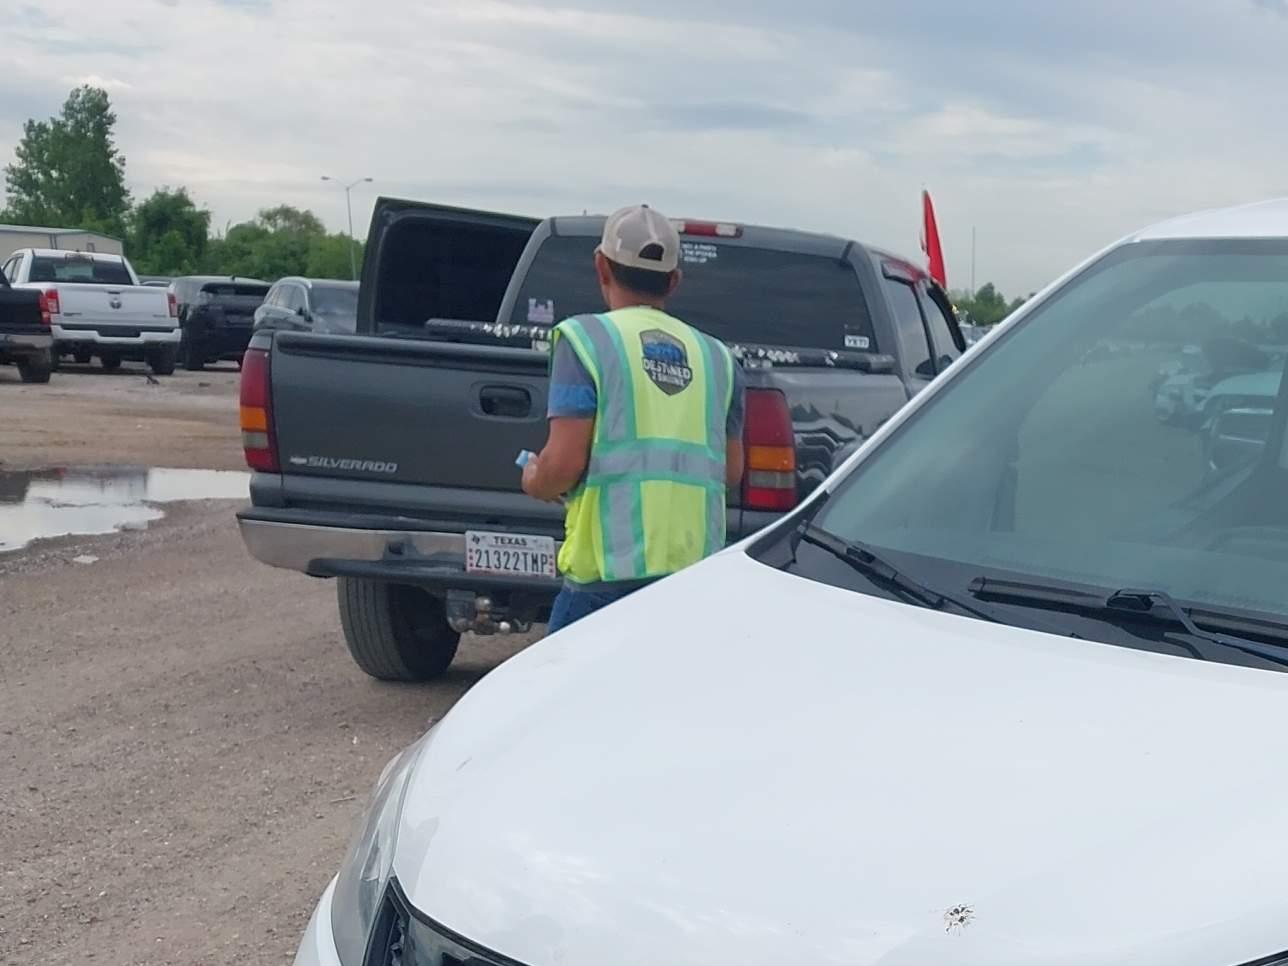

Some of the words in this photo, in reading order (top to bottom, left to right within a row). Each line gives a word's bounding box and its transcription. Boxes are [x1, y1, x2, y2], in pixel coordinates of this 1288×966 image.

[308, 456, 398, 473] SILVERADO
[494, 536, 528, 546] TEXAS
[475, 549, 549, 573] 21322TMP
